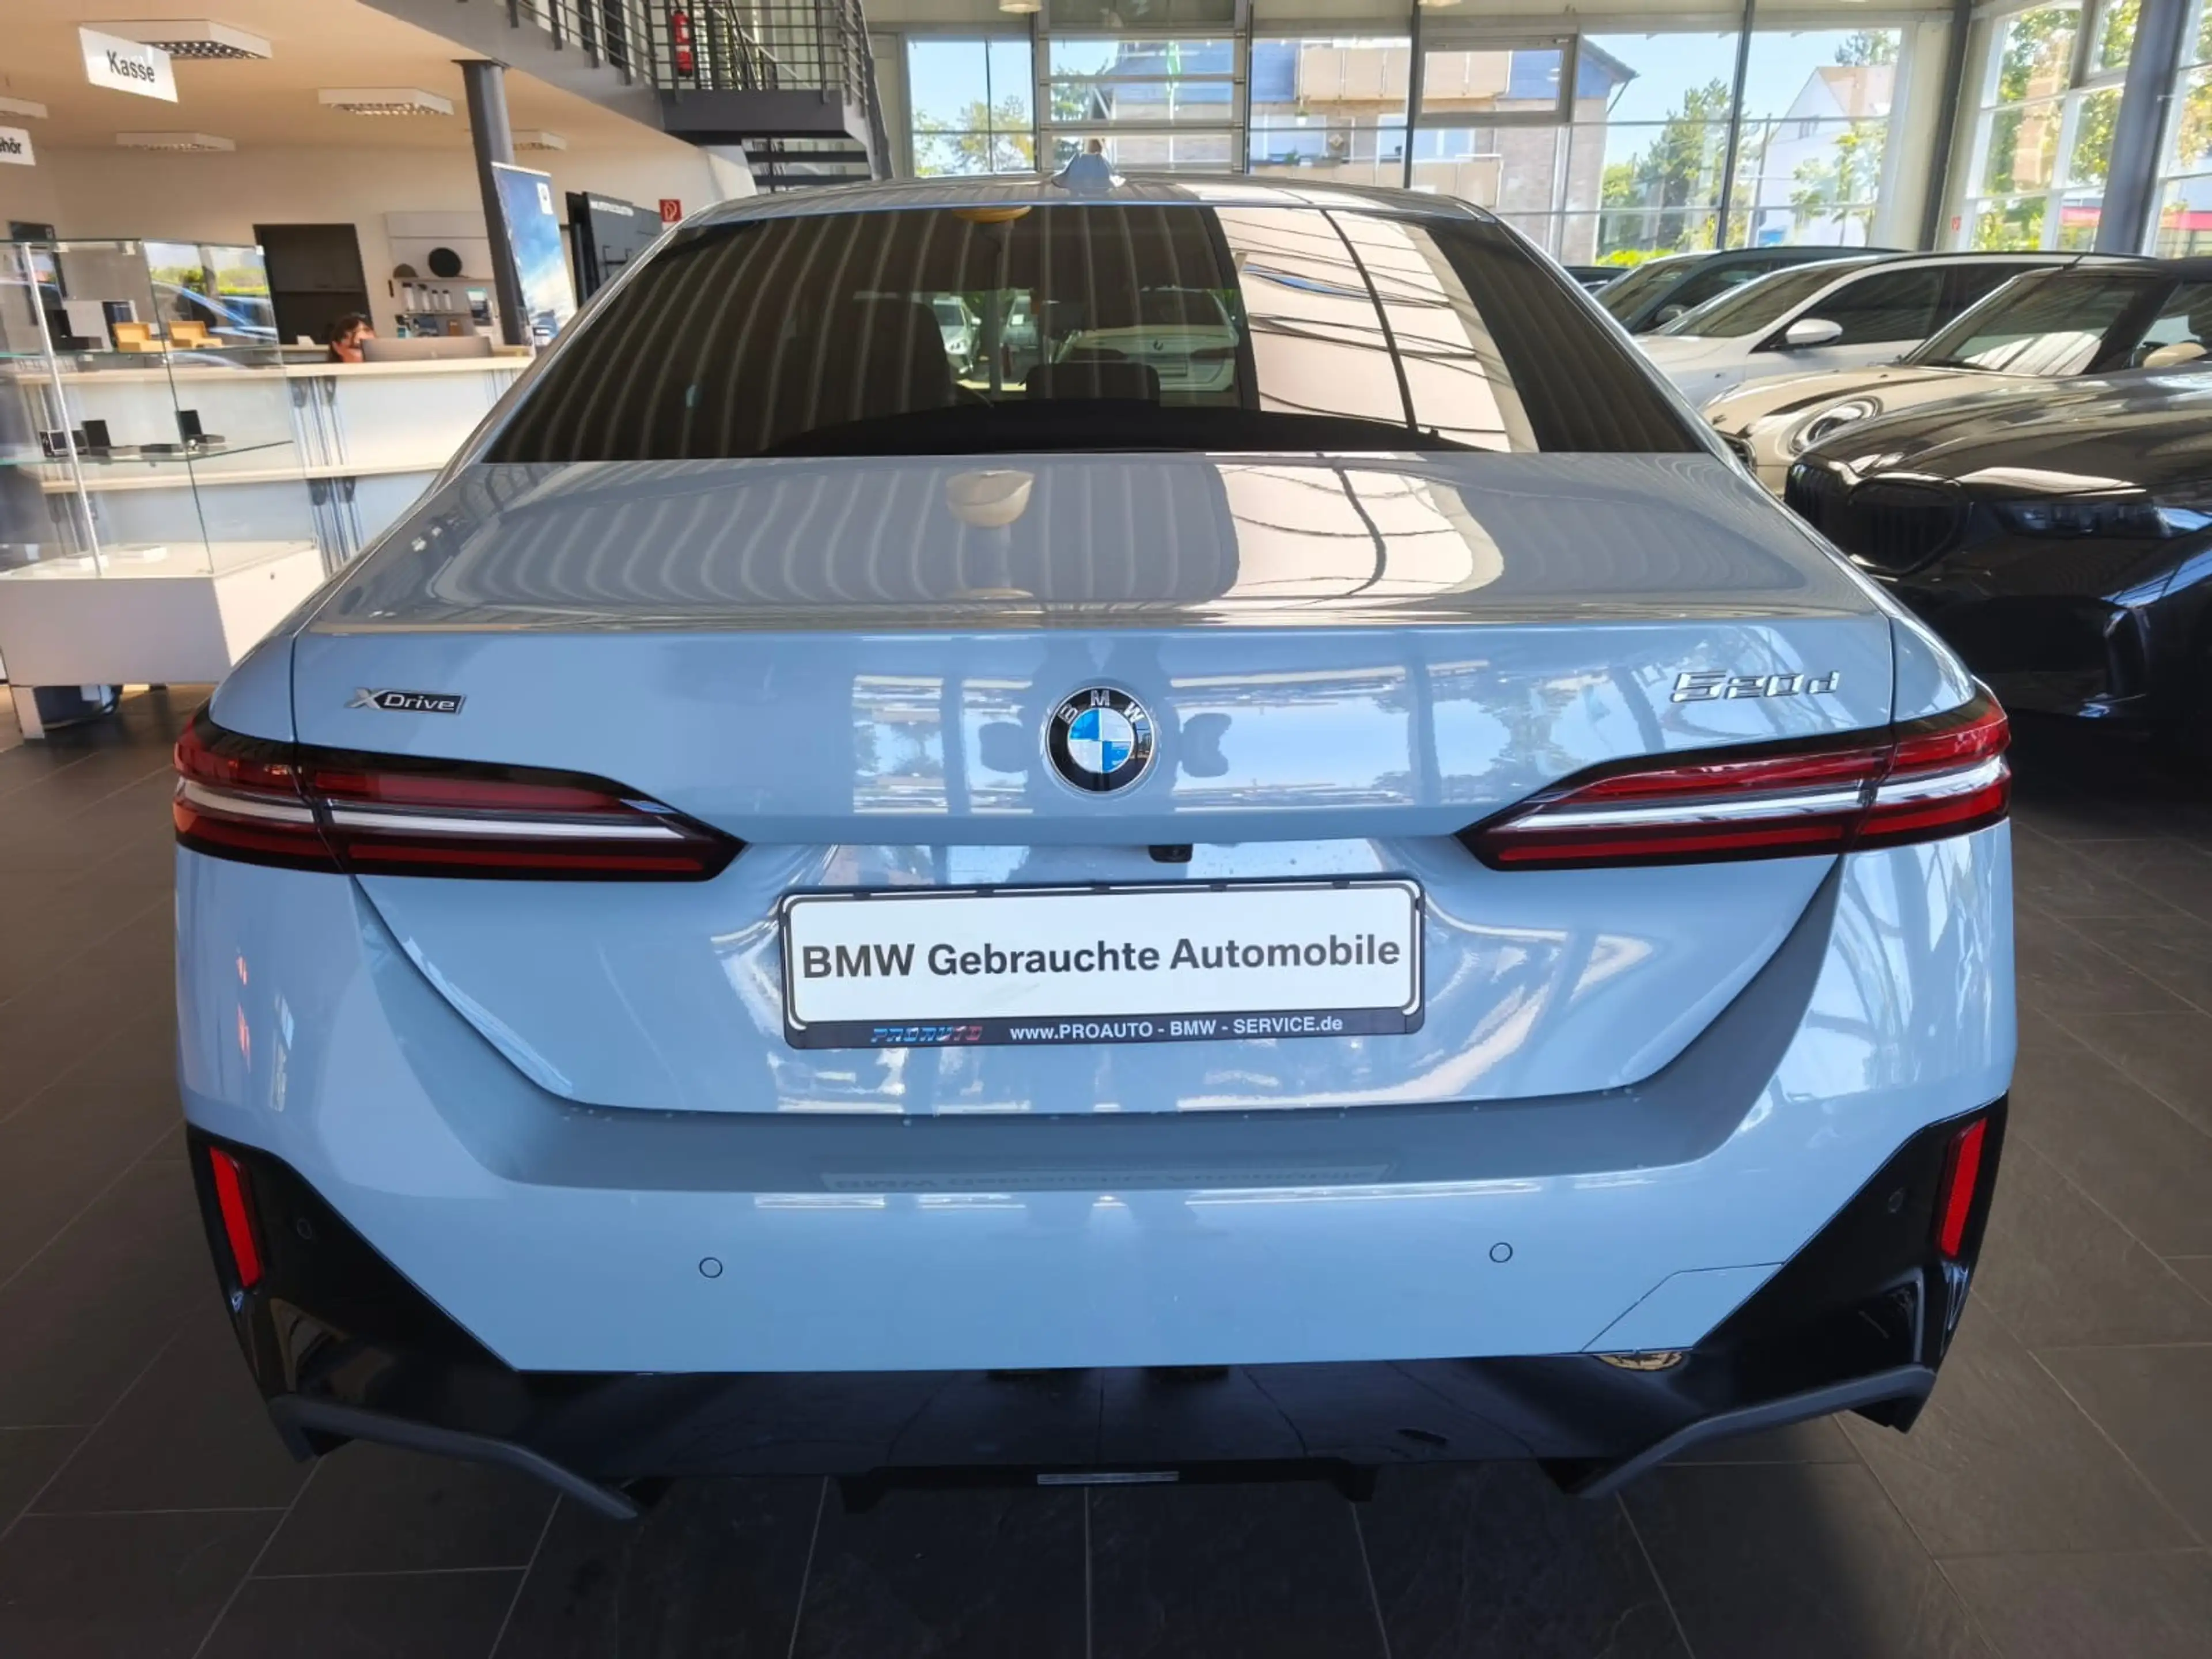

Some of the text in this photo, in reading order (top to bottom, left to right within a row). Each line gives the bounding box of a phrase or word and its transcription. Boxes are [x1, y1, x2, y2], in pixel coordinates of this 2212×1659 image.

[106, 50, 156, 82] Kasse
[1670, 669, 1840, 703] 520d
[1058, 690, 1145, 725] BMW
[802, 934, 1401, 979] BMW Gebrauchte Automobile
